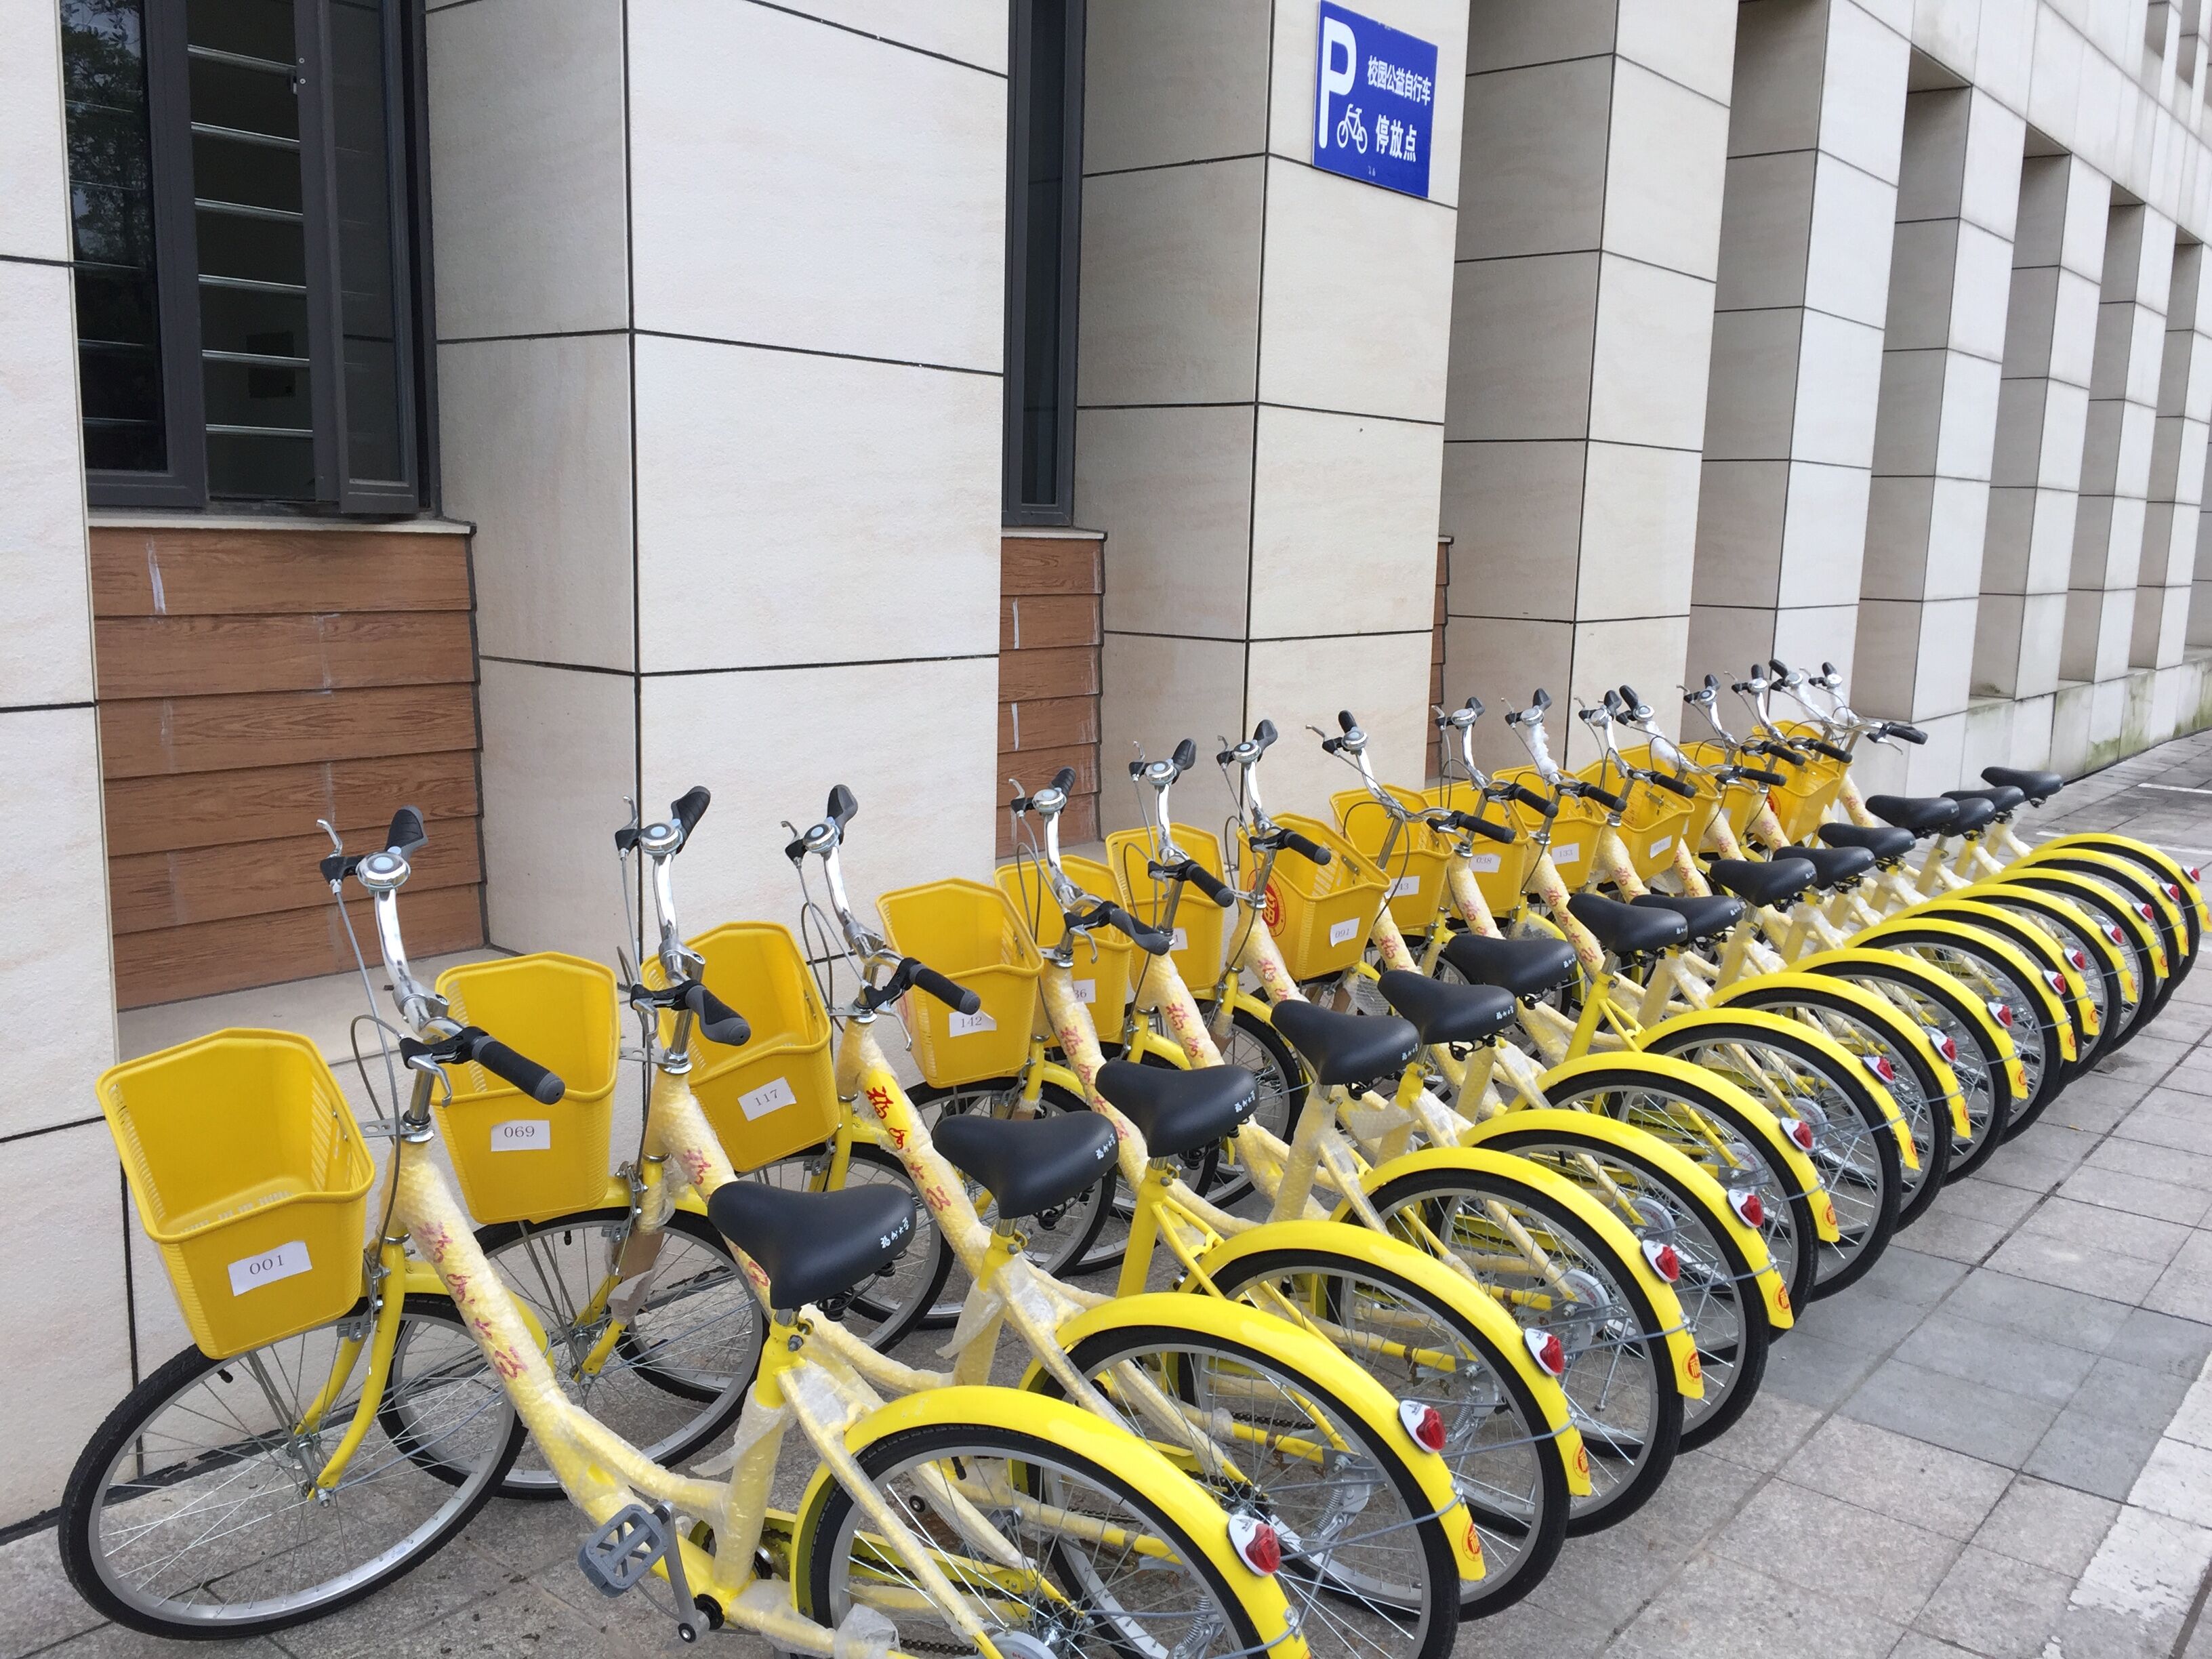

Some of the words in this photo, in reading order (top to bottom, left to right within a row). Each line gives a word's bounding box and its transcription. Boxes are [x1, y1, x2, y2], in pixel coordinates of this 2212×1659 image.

[1319, 16, 1357, 149] P
[1367, 55, 1432, 106] 校园公益自行车
[1375, 114, 1417, 162] 停放点
[1334, 928, 1351, 938] 091
[961, 1017, 982, 1028] 142
[754, 1088, 777, 1106] 117
[504, 1126, 535, 1138] 069
[249, 1254, 284, 1275] 001
